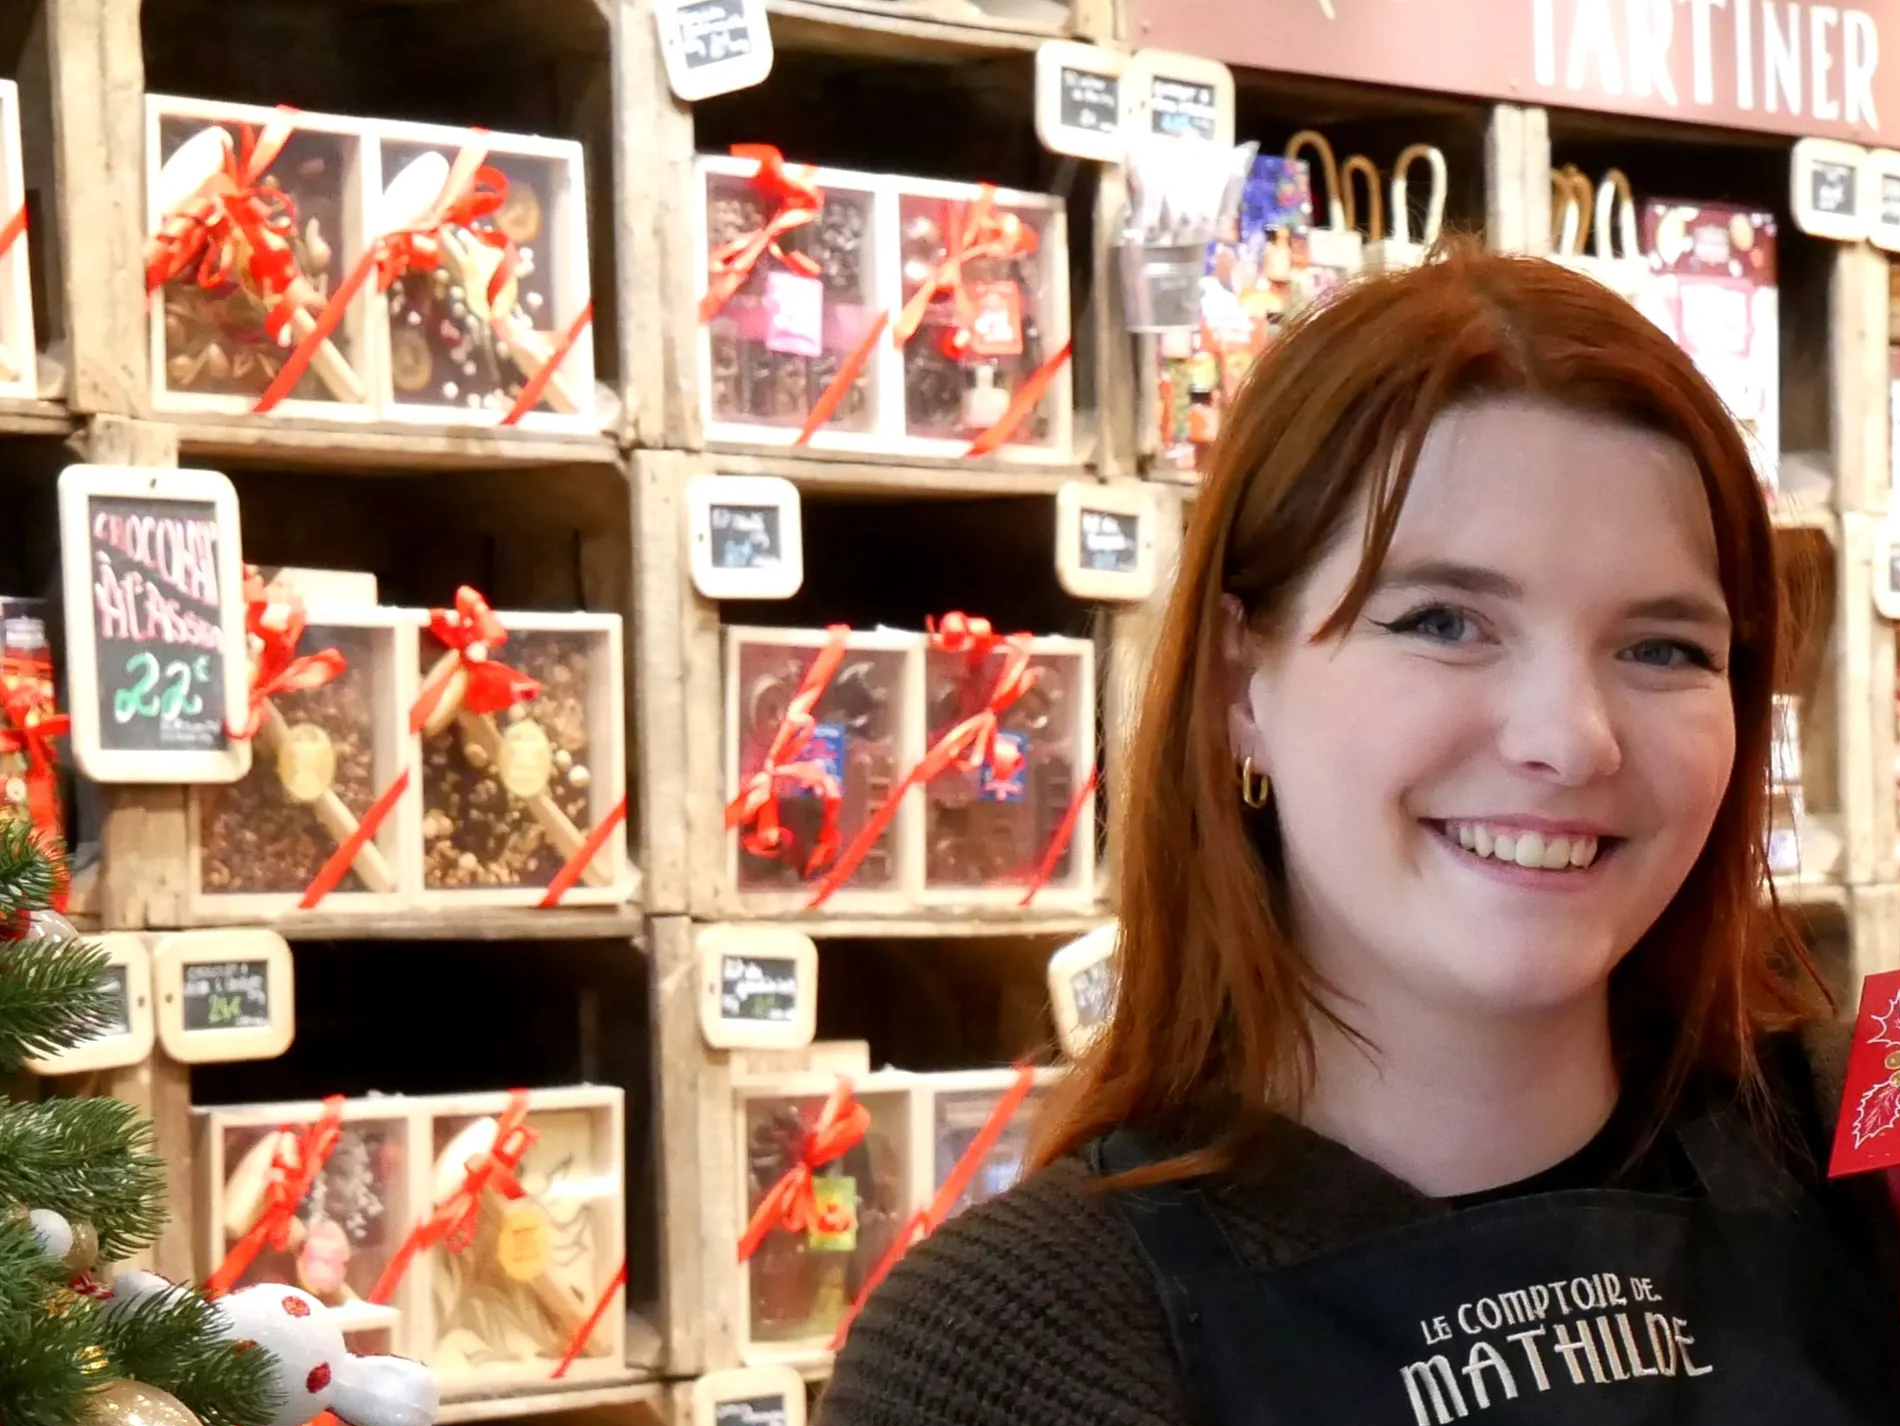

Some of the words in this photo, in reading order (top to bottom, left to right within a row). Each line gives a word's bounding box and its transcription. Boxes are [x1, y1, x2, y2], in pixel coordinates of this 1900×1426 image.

[1420, 1315, 1452, 1345] LE
[1457, 1272, 1627, 1335] COMPTOIR
[1630, 1277, 1663, 1302] DE
